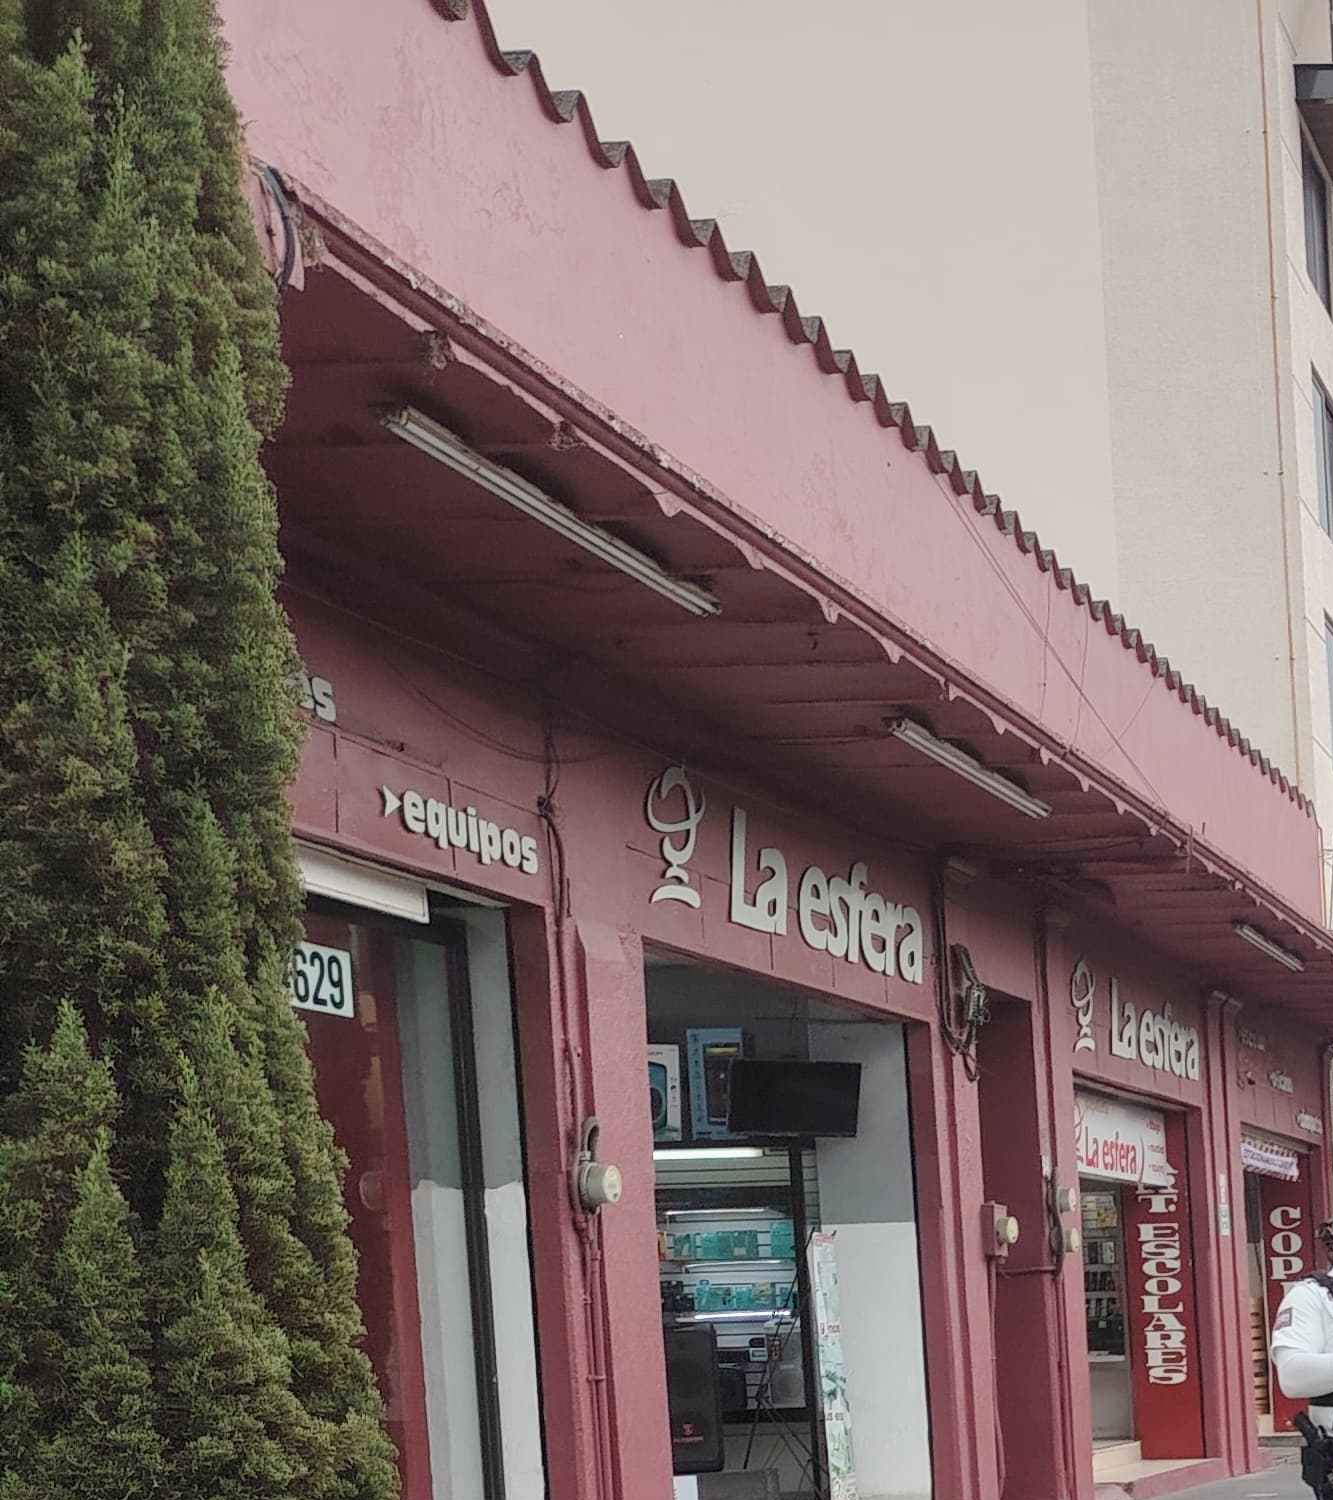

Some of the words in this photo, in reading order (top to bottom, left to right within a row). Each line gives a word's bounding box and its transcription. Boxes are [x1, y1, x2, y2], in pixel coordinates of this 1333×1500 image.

[402, 790, 538, 875] equipos
[730, 804, 788, 937] La
[798, 861, 924, 986] esfera
[1110, 976, 1137, 1061] La
[1138, 1000, 1200, 1082] esfera
[1085, 1125, 1099, 1169] La
[1102, 1130, 1137, 1175] esfera
[1137, 1222, 1188, 1385] ESCOLARES
